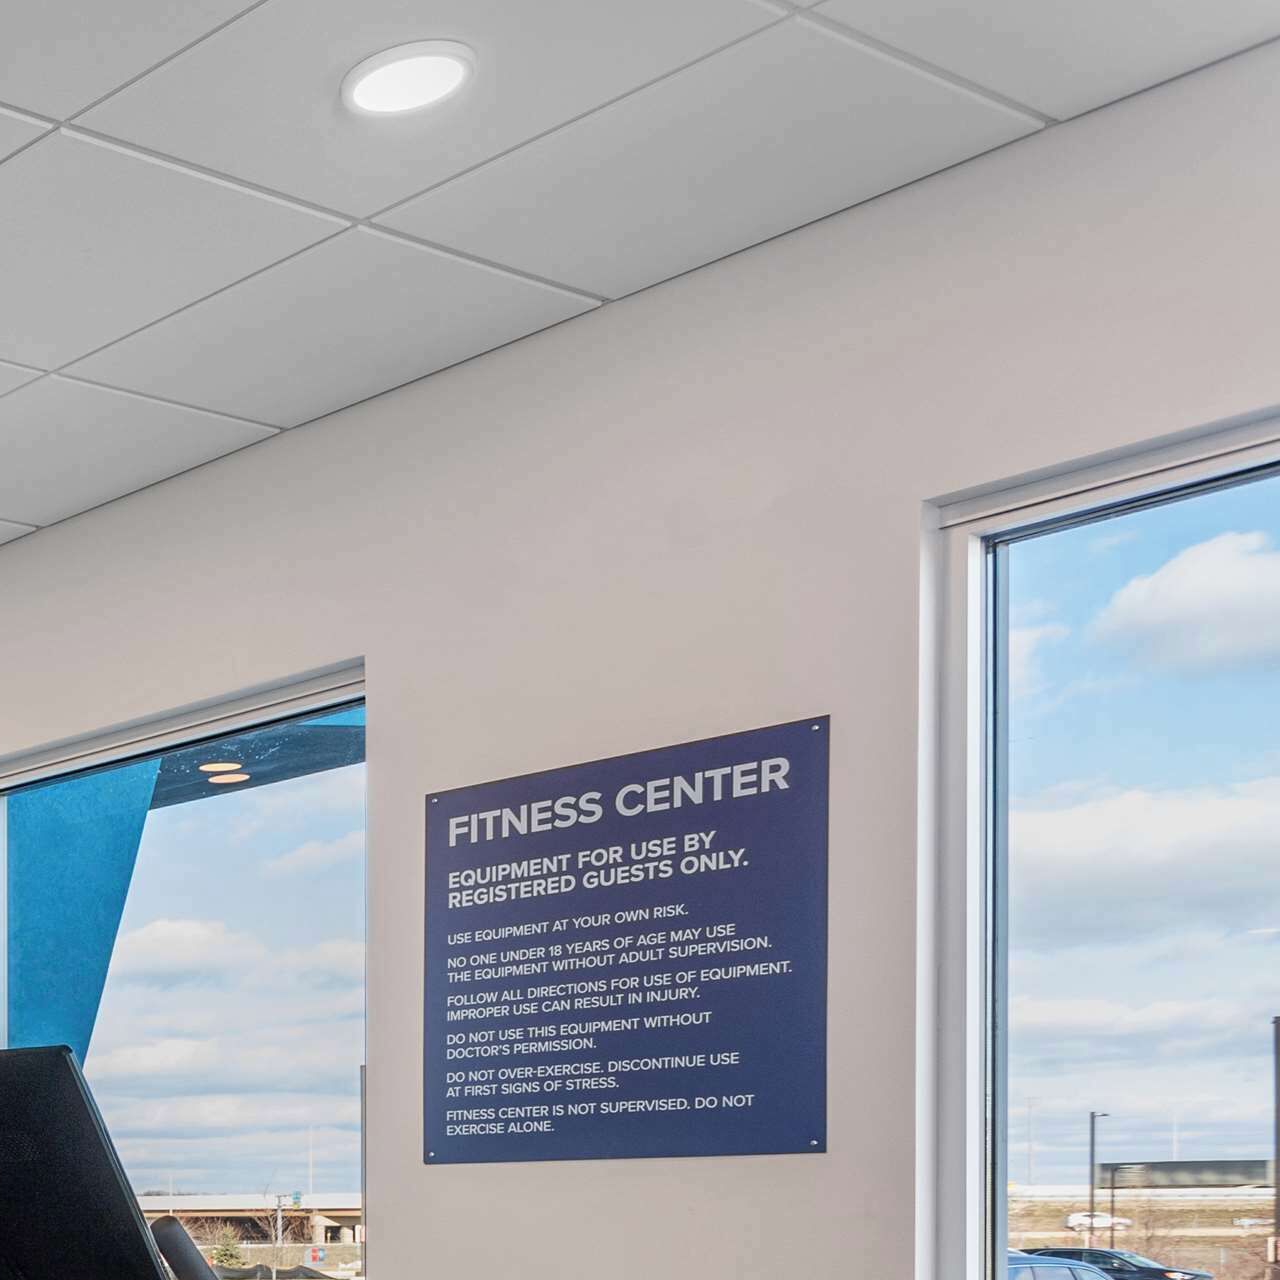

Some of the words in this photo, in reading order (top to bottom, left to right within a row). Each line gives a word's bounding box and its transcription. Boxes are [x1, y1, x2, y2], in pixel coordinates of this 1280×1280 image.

[450, 792, 602, 846] FITNESS
[616, 758, 790, 816] CENTER
[449, 854, 571, 888] EQUIPMENT
[578, 846, 622, 868] FOR
[631, 837, 676, 860] USE
[684, 830, 716, 852] BY
[448, 875, 576, 908] REGISTERED
[583, 860, 672, 888] GUESTS
[680, 849, 748, 874] ONLY.
[448, 932, 472, 945] USE
[475, 922, 549, 942] EQUIPMENT
[552, 919, 568, 932] AT
[572, 914, 610, 928] YOUR
[615, 908, 649, 923] OWN
[654, 904, 688, 918] RISK.
[448, 957, 466, 968] NO
[470, 953, 496, 966] ONE
[501, 947, 545, 962] UNDER
[549, 945, 562, 956] 18
[566, 939, 610, 954] YEARS
[614, 936, 633, 949] OF
[636, 932, 666, 946] AGE
[670, 928, 702, 942] MAY
[706, 924, 735, 938] USE
[448, 971, 471, 982] THE
[475, 962, 549, 980] EQUIPMENT
[552, 954, 615, 971] WITHOUT
[619, 948, 664, 964] ADULT
[669, 936, 772, 958] SUPERVISION.
[448, 992, 498, 1006] FOLLOW
[501, 990, 524, 1001] ALL
[528, 980, 607, 998] DIRECTIONS
[611, 977, 639, 990] FOR
[644, 974, 672, 987] USE
[676, 971, 696, 983] OF
[701, 961, 792, 981] EQUIPMENT.
[447, 1006, 509, 1021] IMPROPER
[514, 1002, 538, 1015] USE
[542, 1000, 570, 1012] CAN
[575, 994, 624, 1009] RESULT
[628, 992, 642, 1004] IN
[647, 987, 700, 1002] INJURY.
[447, 1034, 465, 1045] DO
[469, 1031, 495, 1042] NOT
[499, 1028, 524, 1040] USE
[527, 1026, 556, 1038] THIS
[560, 1018, 640, 1035] EQUIPMENT
[644, 1012, 712, 1028] WITHOUT
[447, 1044, 510, 1059] DOCTOR'S
[514, 1038, 596, 1054] PERMISSION.
[447, 1072, 465, 1082] DO
[469, 1070, 495, 1081] NOT
[498, 1062, 604, 1079] OVER-EXERCISE.
[608, 1055, 706, 1072] DISCONTINUE
[710, 1052, 739, 1065] USE
[446, 1086, 461, 1097] AT
[465, 1084, 498, 1096] FIRST
[502, 1082, 540, 1094] SIGNS
[544, 1080, 562, 1092] OF
[566, 1077, 619, 1090] STRESS.
[447, 1108, 495, 1120] FITNESS
[499, 1106, 548, 1118] CENTER
[553, 1105, 564, 1116] IS
[568, 1103, 596, 1115] NOT
[600, 1098, 690, 1113] SUPERVISED.
[695, 1096, 718, 1108] DO
[722, 1094, 754, 1107] NOT
[447, 1123, 504, 1136] EXERCISE
[508, 1120, 554, 1133] ALONE.
